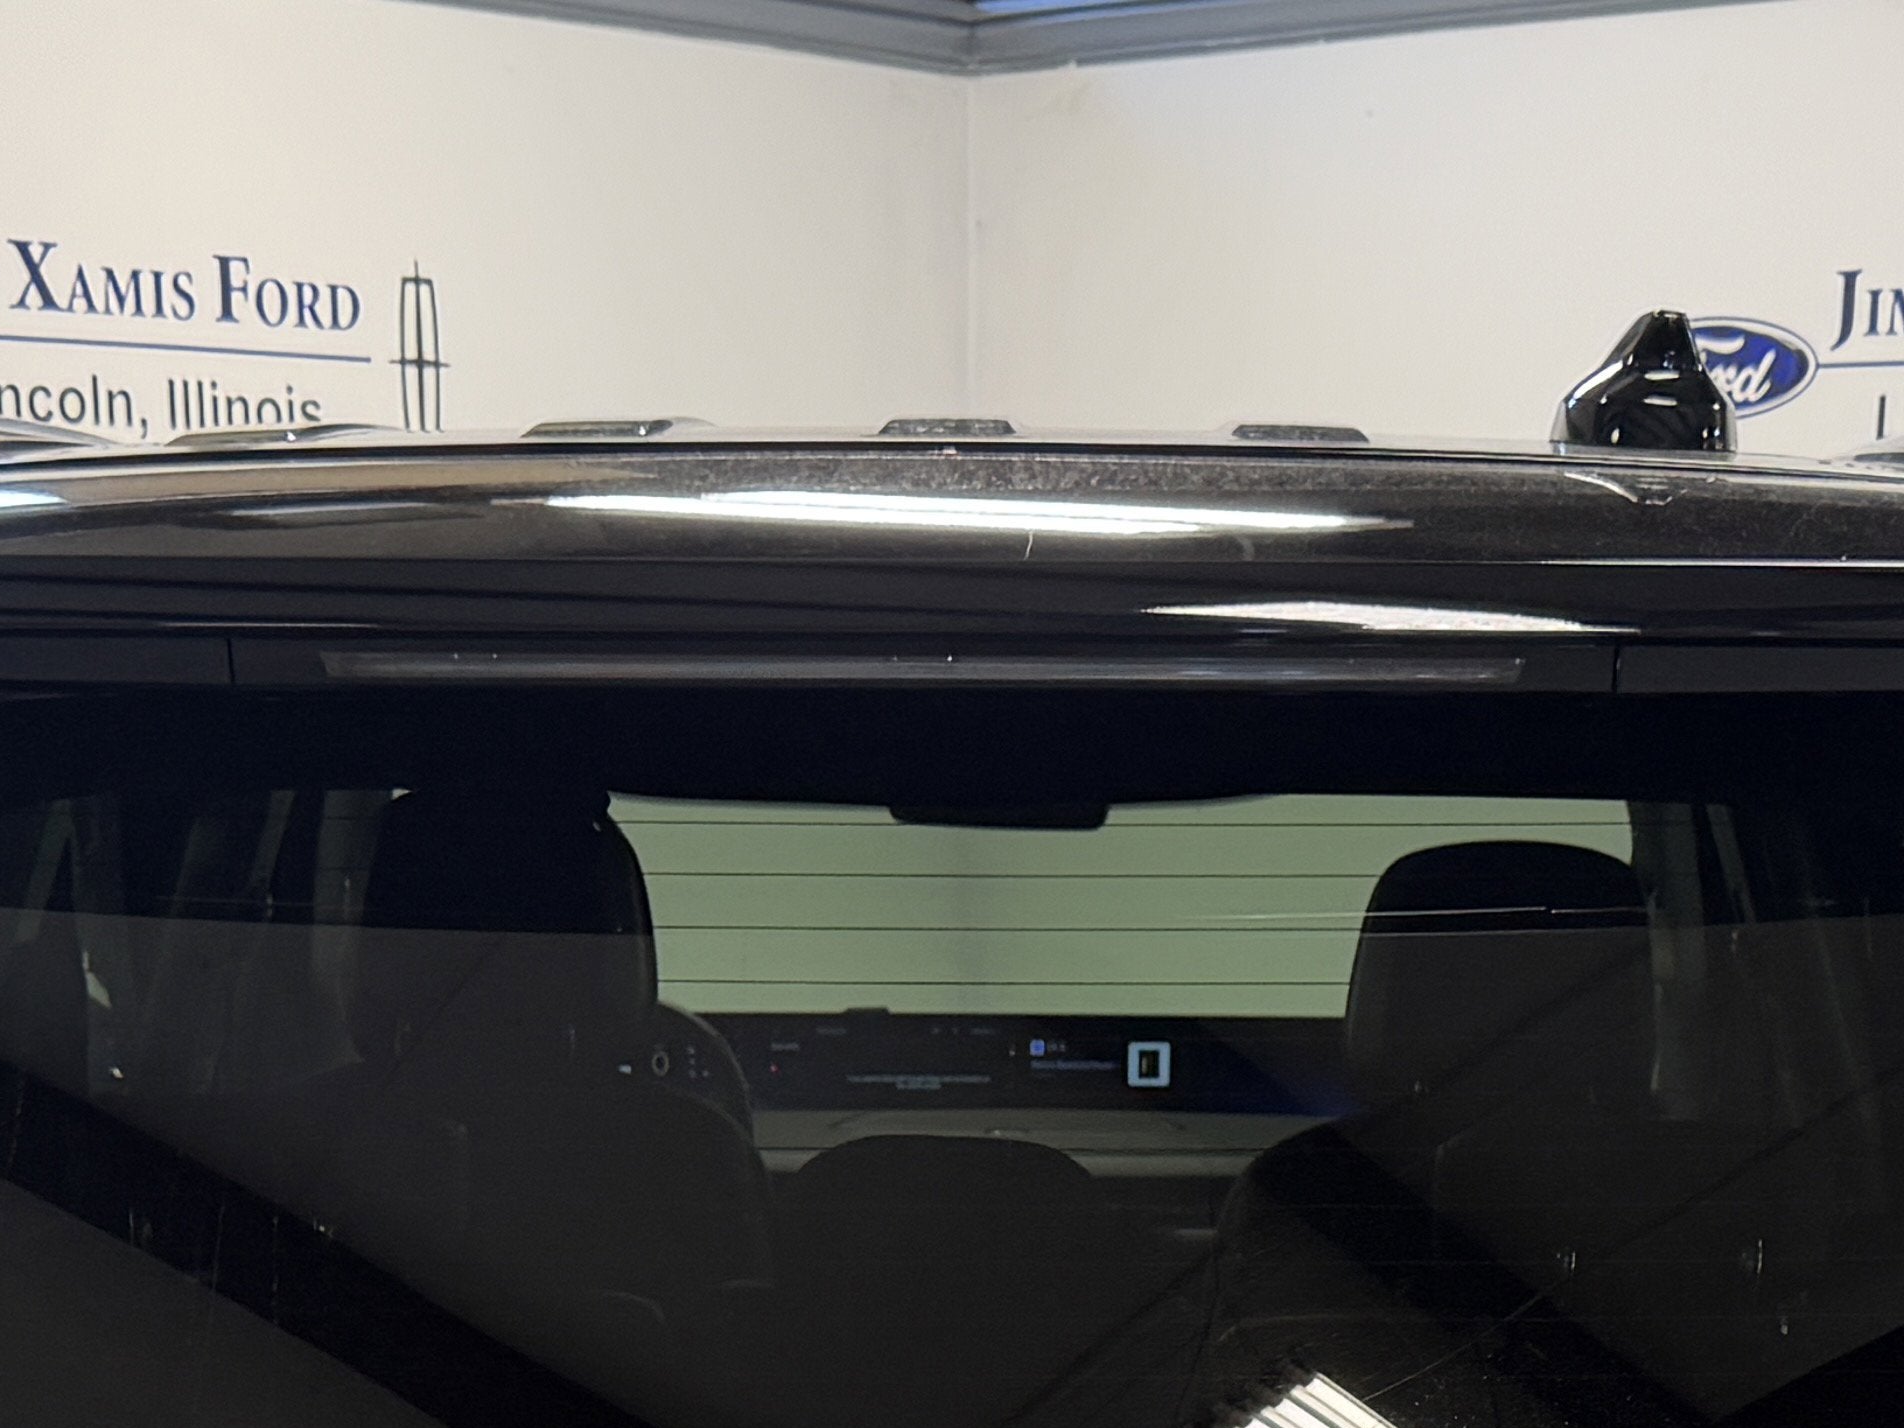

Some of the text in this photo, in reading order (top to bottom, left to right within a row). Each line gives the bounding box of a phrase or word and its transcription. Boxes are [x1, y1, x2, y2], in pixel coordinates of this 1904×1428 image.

[7, 239, 196, 321] XAMIS
[212, 254, 361, 331] FORD
[167, 378, 322, 431] Illinois
